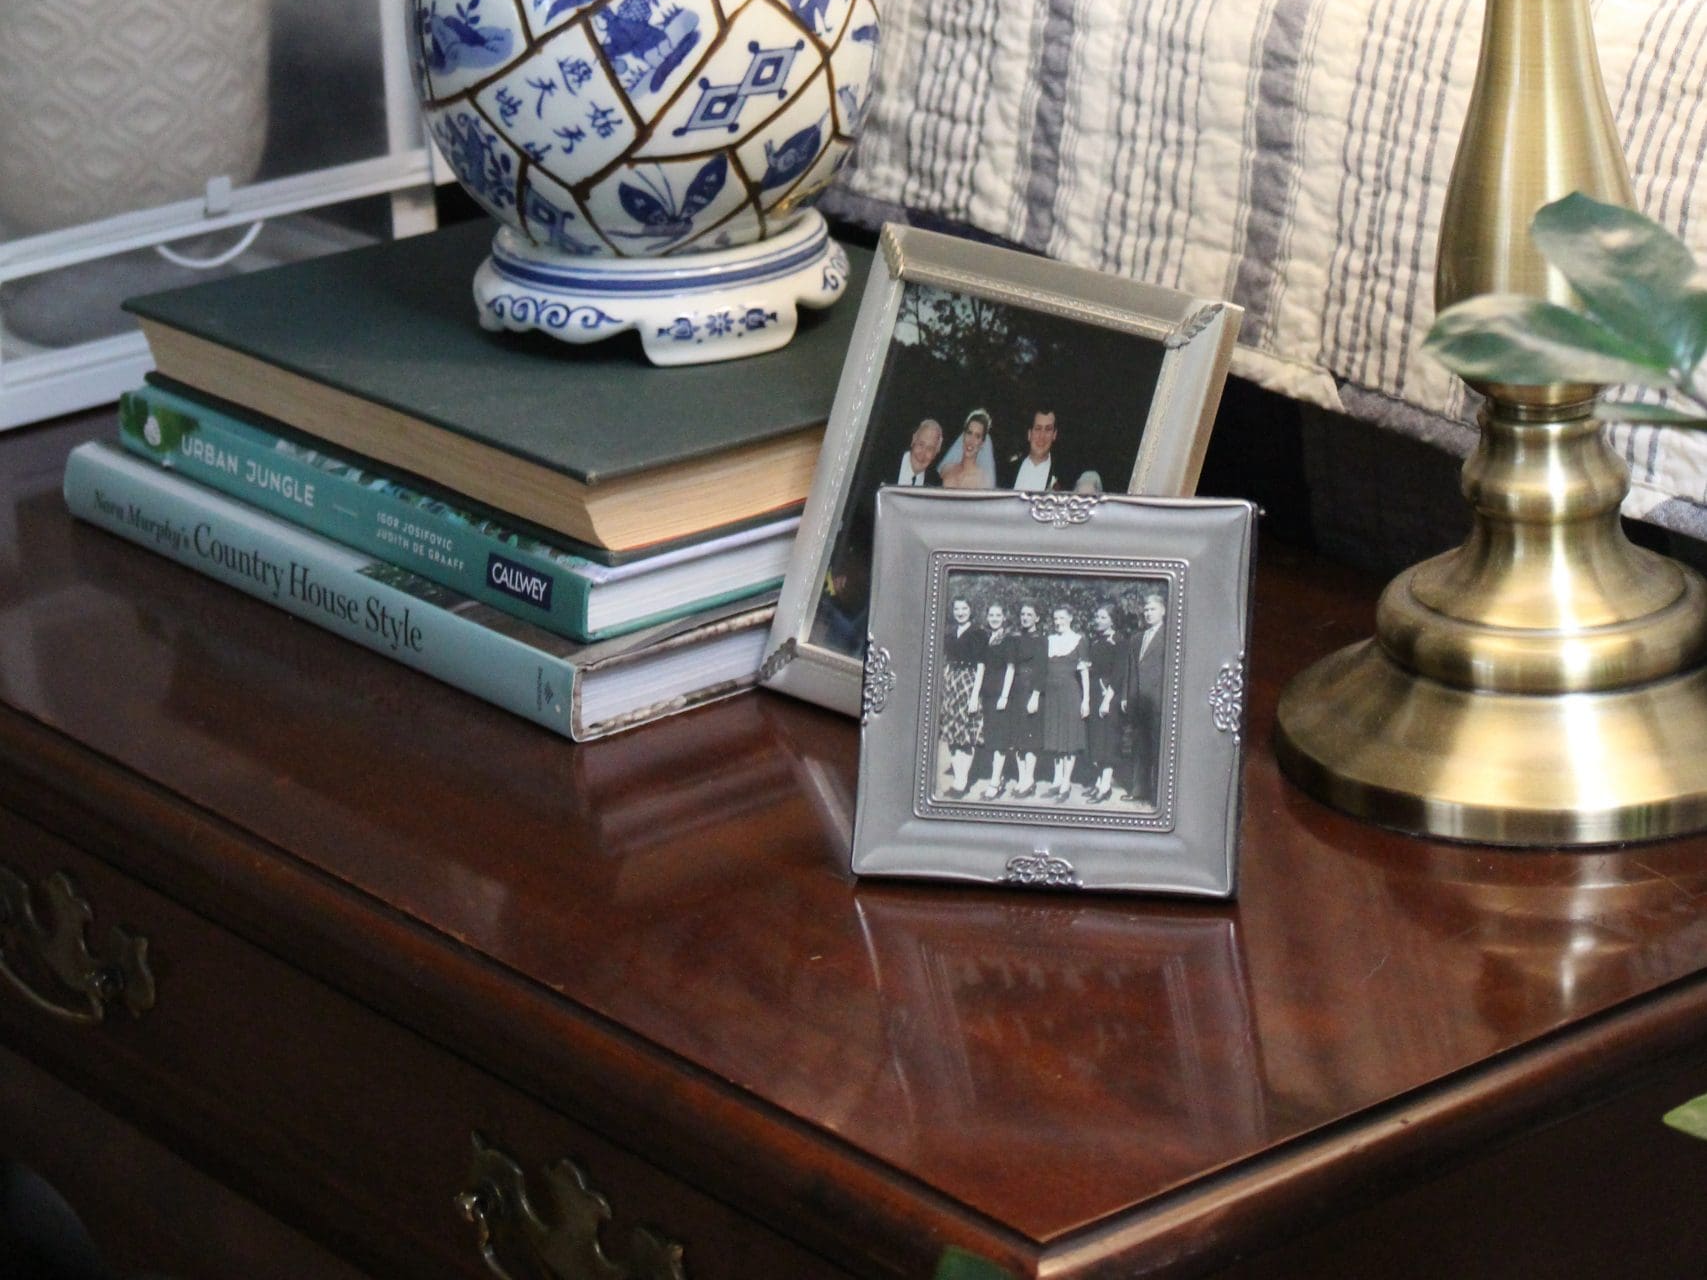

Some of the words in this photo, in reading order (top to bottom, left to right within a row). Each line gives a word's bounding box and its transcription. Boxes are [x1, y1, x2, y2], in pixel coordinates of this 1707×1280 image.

[181, 434, 238, 475] URBAN
[245, 460, 315, 507] JUNGLE
[376, 512, 399, 528] IGOR
[376, 528, 409, 551] JUDITH
[412, 541, 424, 556] DE
[427, 548, 464, 571] GRAAFF
[127, 504, 189, 551] Murphy's
[194, 522, 284, 598] Country
[289, 561, 359, 624] House
[365, 595, 424, 652] Style
[491, 562, 547, 602] CALLWEY
